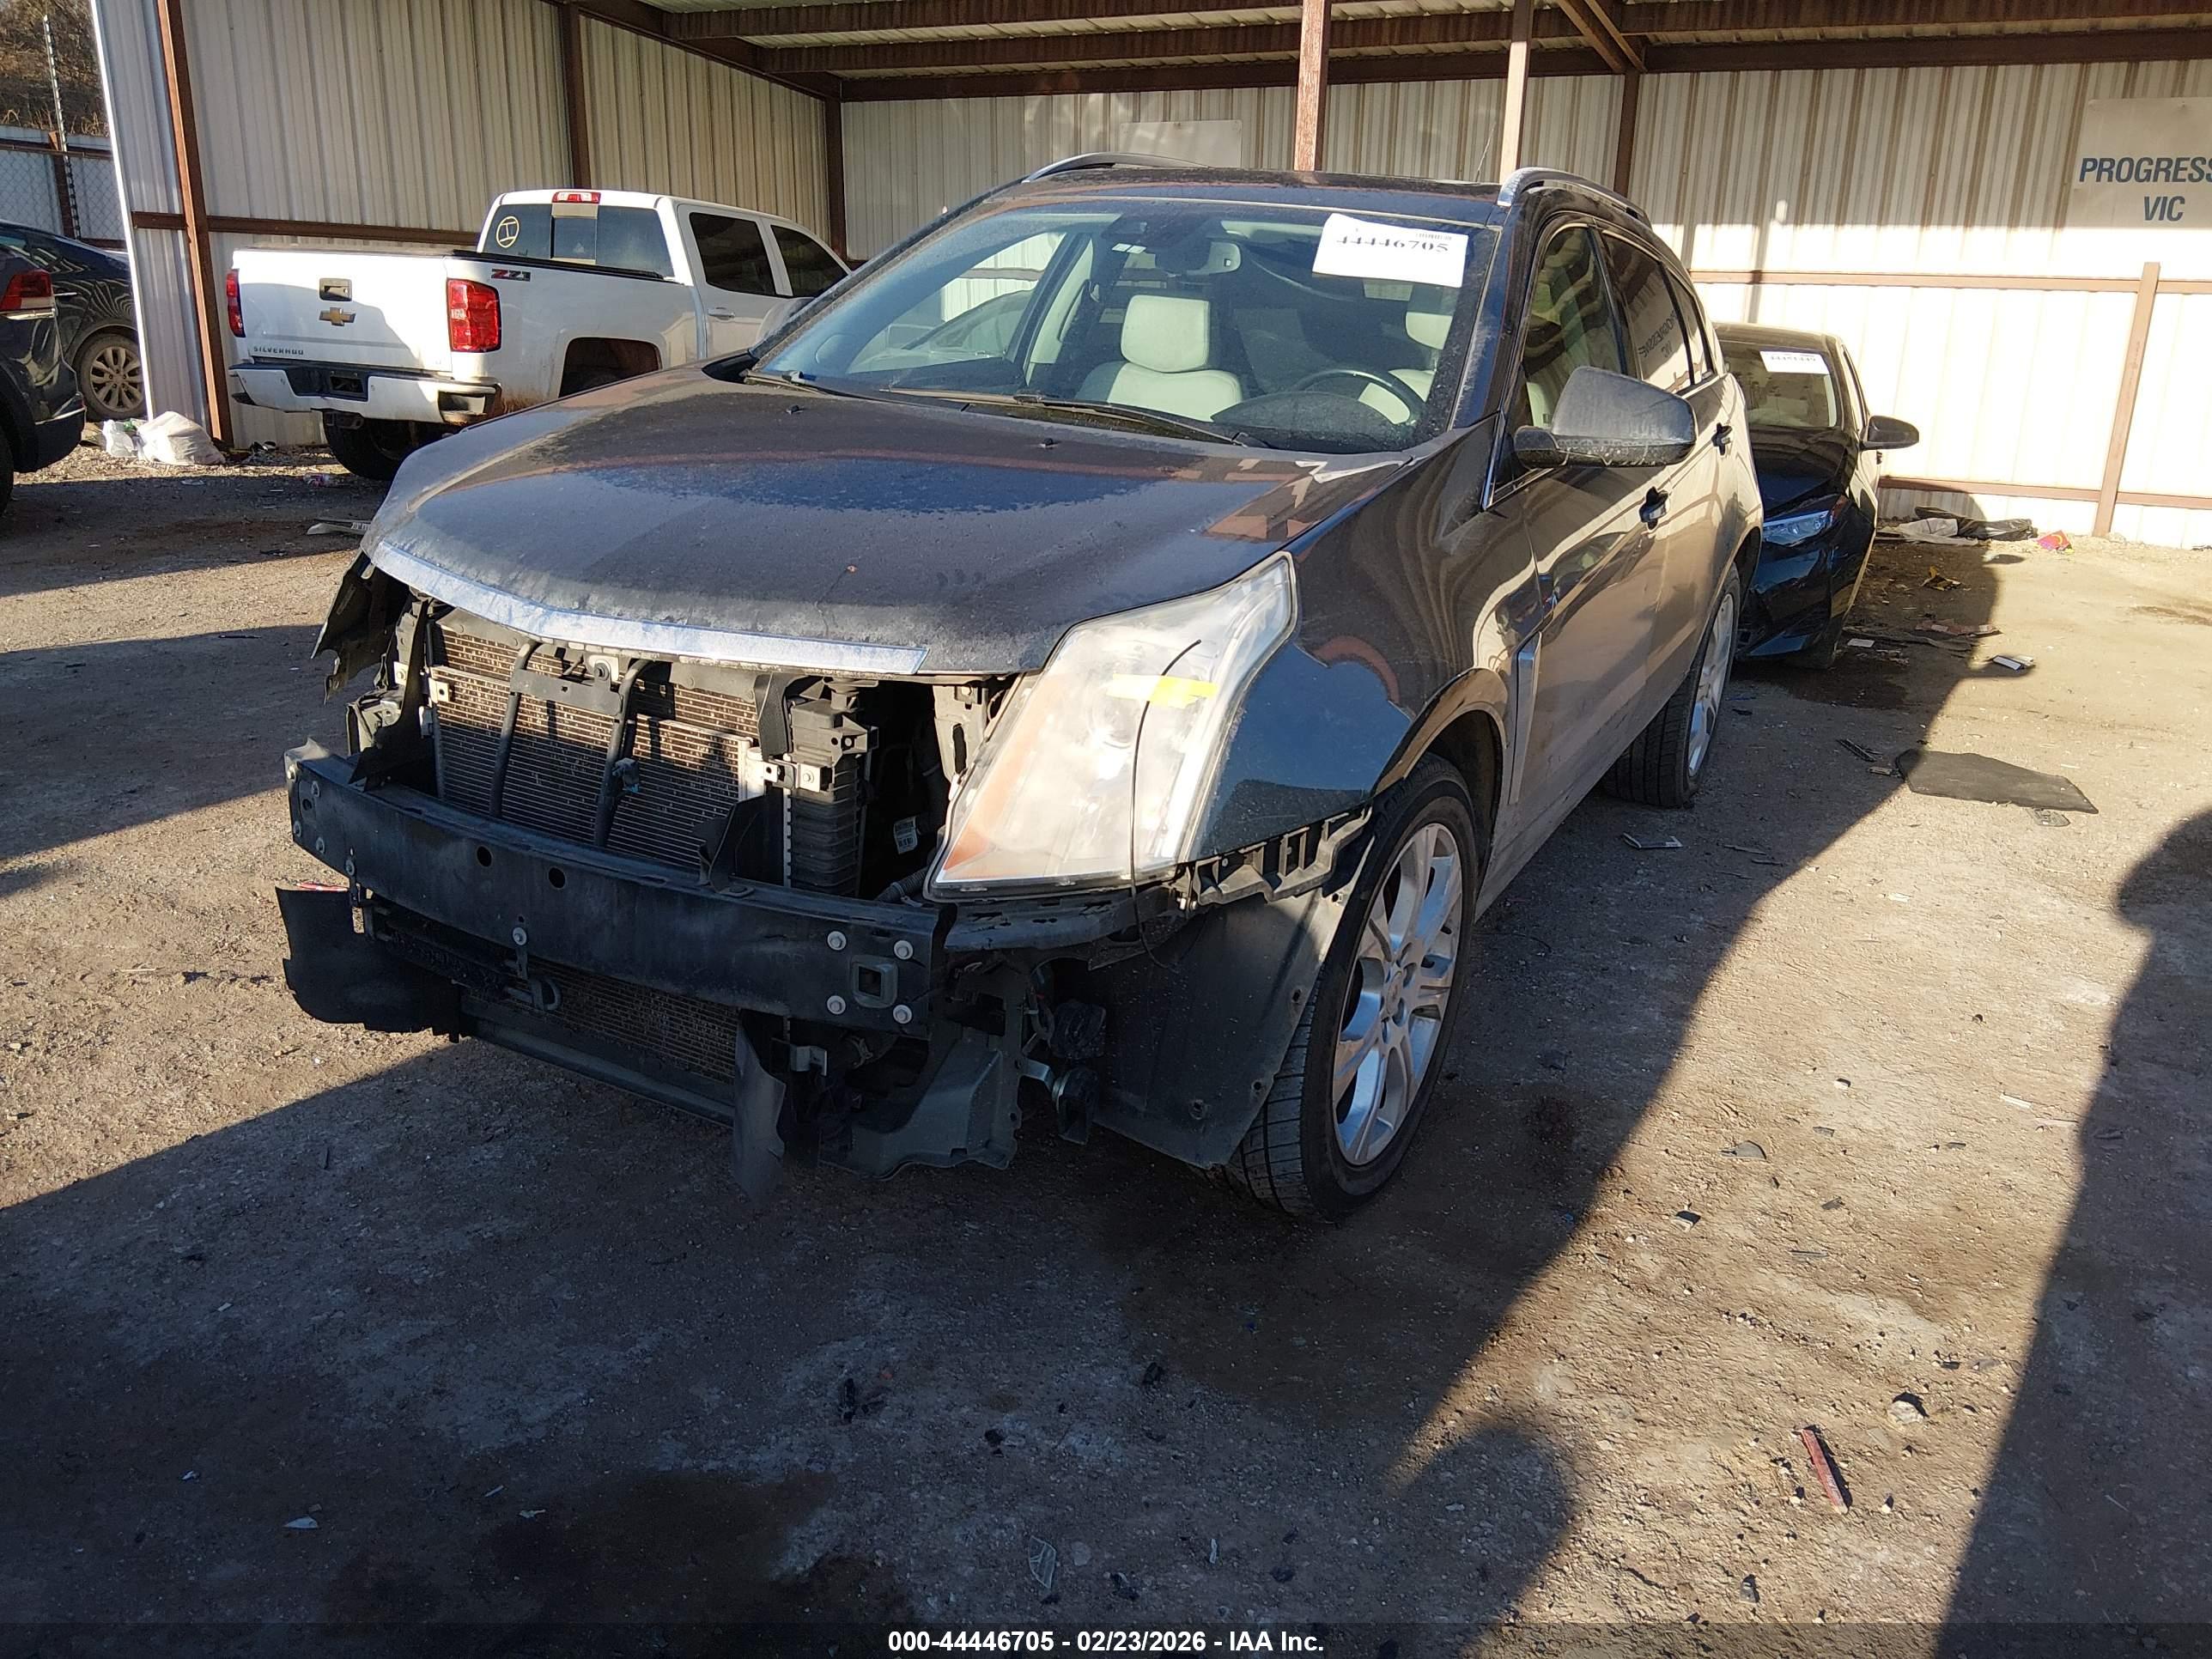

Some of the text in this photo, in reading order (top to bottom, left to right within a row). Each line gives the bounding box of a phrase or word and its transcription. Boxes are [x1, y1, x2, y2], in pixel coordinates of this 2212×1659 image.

[2143, 195, 2185, 222] VIC
[1336, 235, 1449, 252] 44446705
[490, 268, 532, 282] Z71
